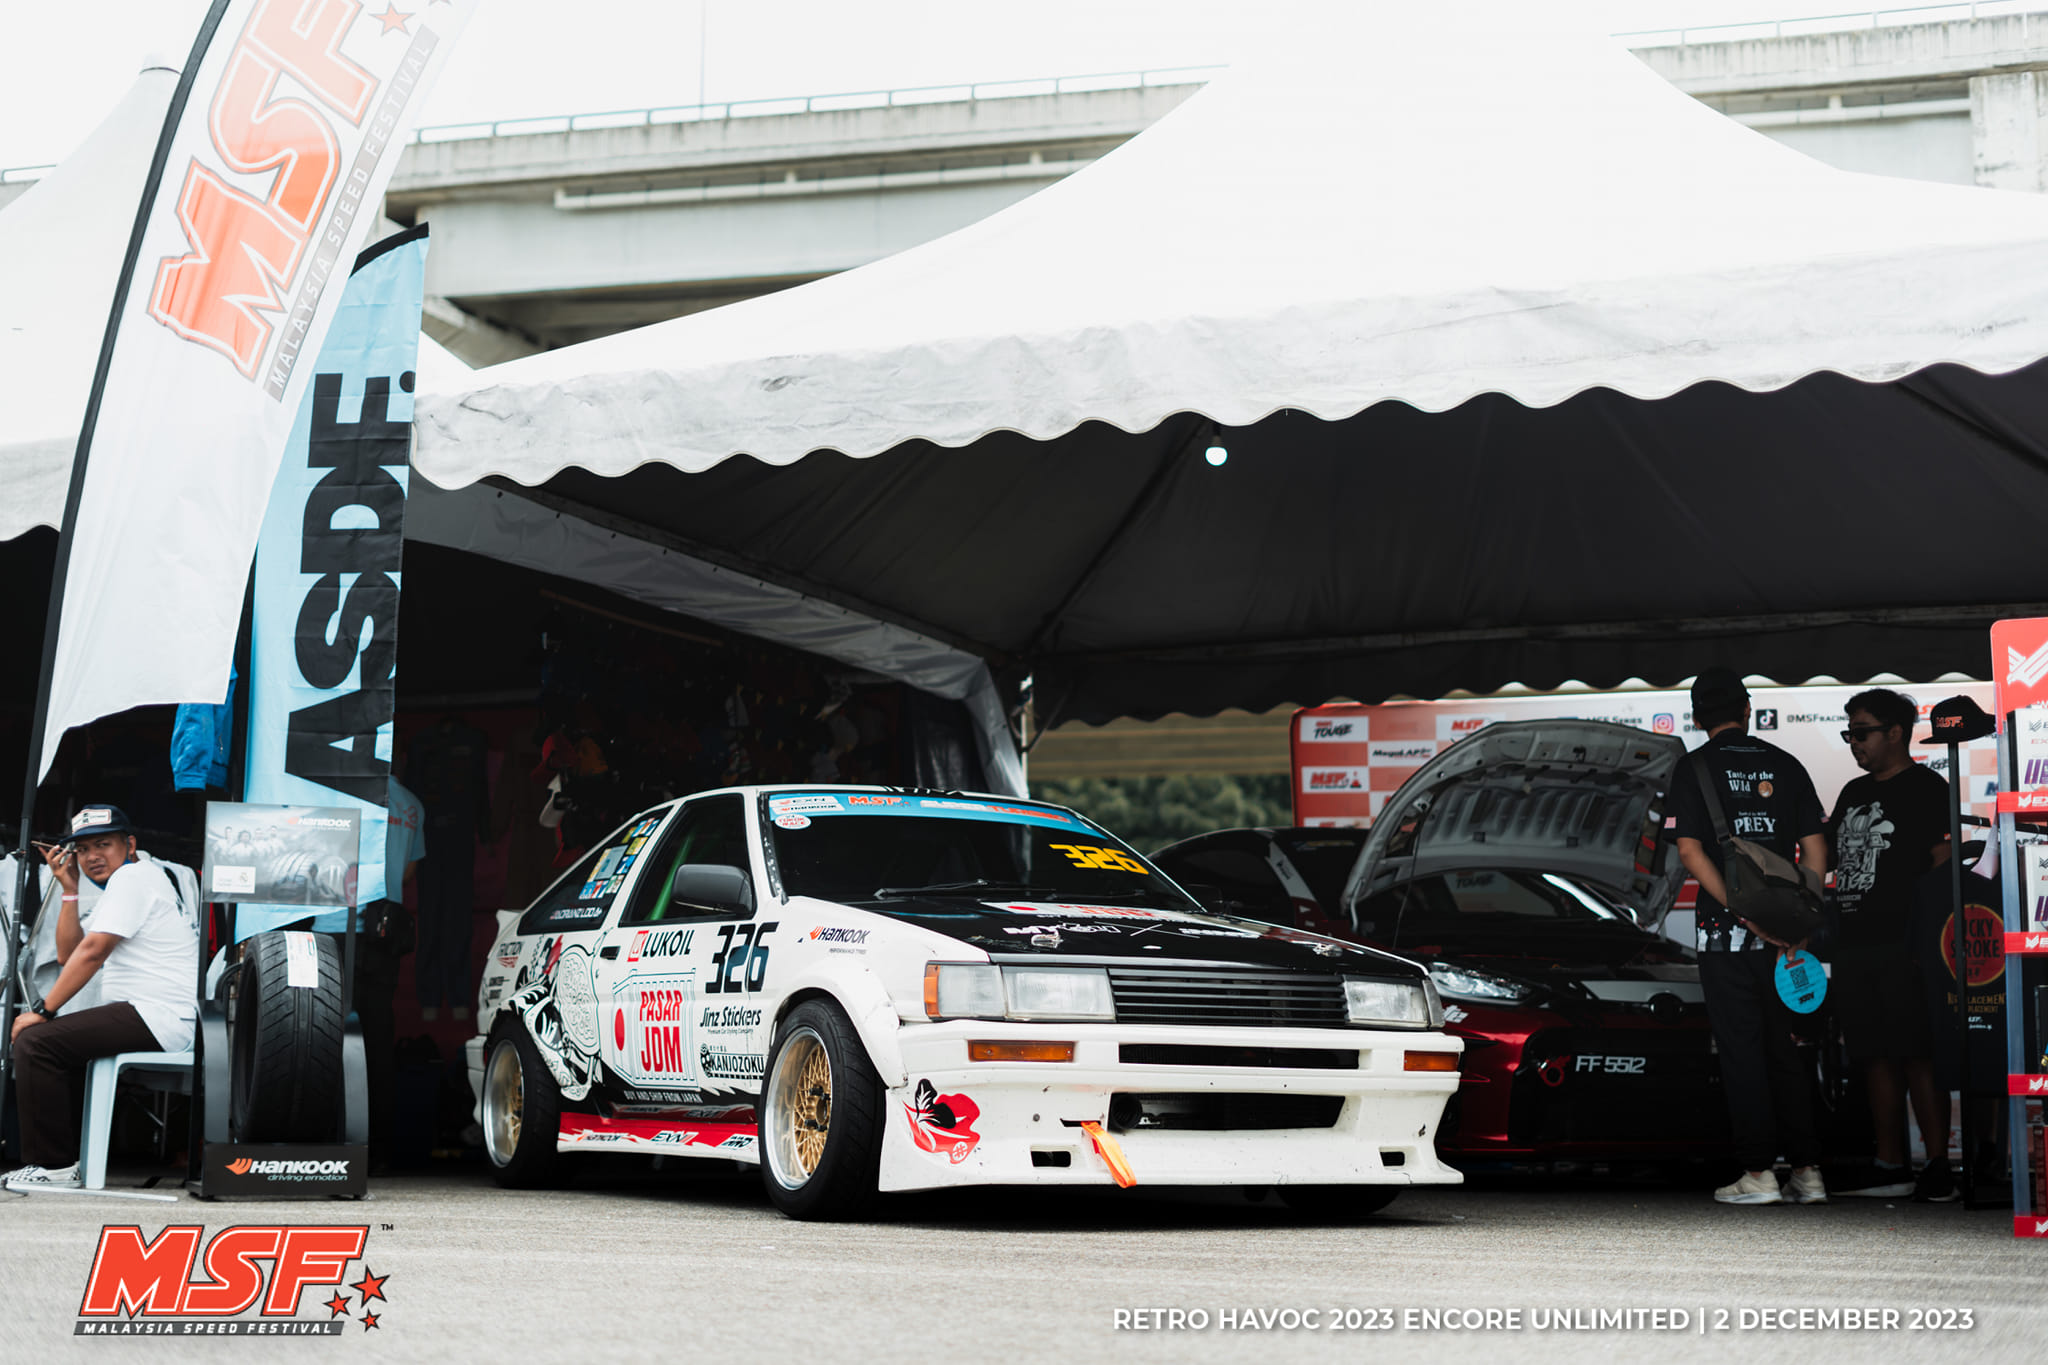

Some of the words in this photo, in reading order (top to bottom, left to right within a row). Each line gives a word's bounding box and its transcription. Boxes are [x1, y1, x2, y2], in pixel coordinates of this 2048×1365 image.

[147, 0, 382, 383] MSF
[272, 256, 331, 389] MALAYSIA
[327, 167, 369, 249] SPEED
[364, 45, 431, 159] FESTIVAL
[1747, 771, 1757, 781] of
[1759, 770, 1774, 780] the
[848, 796, 902, 806] MSF
[1733, 816, 1776, 835] PREY
[1048, 844, 1150, 876] 326
[642, 929, 695, 958] LUKOIL
[705, 921, 780, 994] 326
[639, 990, 683, 1022] PASAR
[699, 1006, 720, 1028] Jinz
[721, 1005, 762, 1027] Stickers
[640, 1026, 683, 1073] JDM
[709, 1055, 765, 1074] KANJOZOKU
[1575, 1055, 1603, 1072] FF
[1604, 1056, 1646, 1073] 5512
[623, 1090, 637, 1100] BUY
[636, 1091, 650, 1101] AND
[662, 1092, 683, 1103] FROM
[681, 1093, 704, 1104] JAPAN
[267, 1174, 303, 1182] driving
